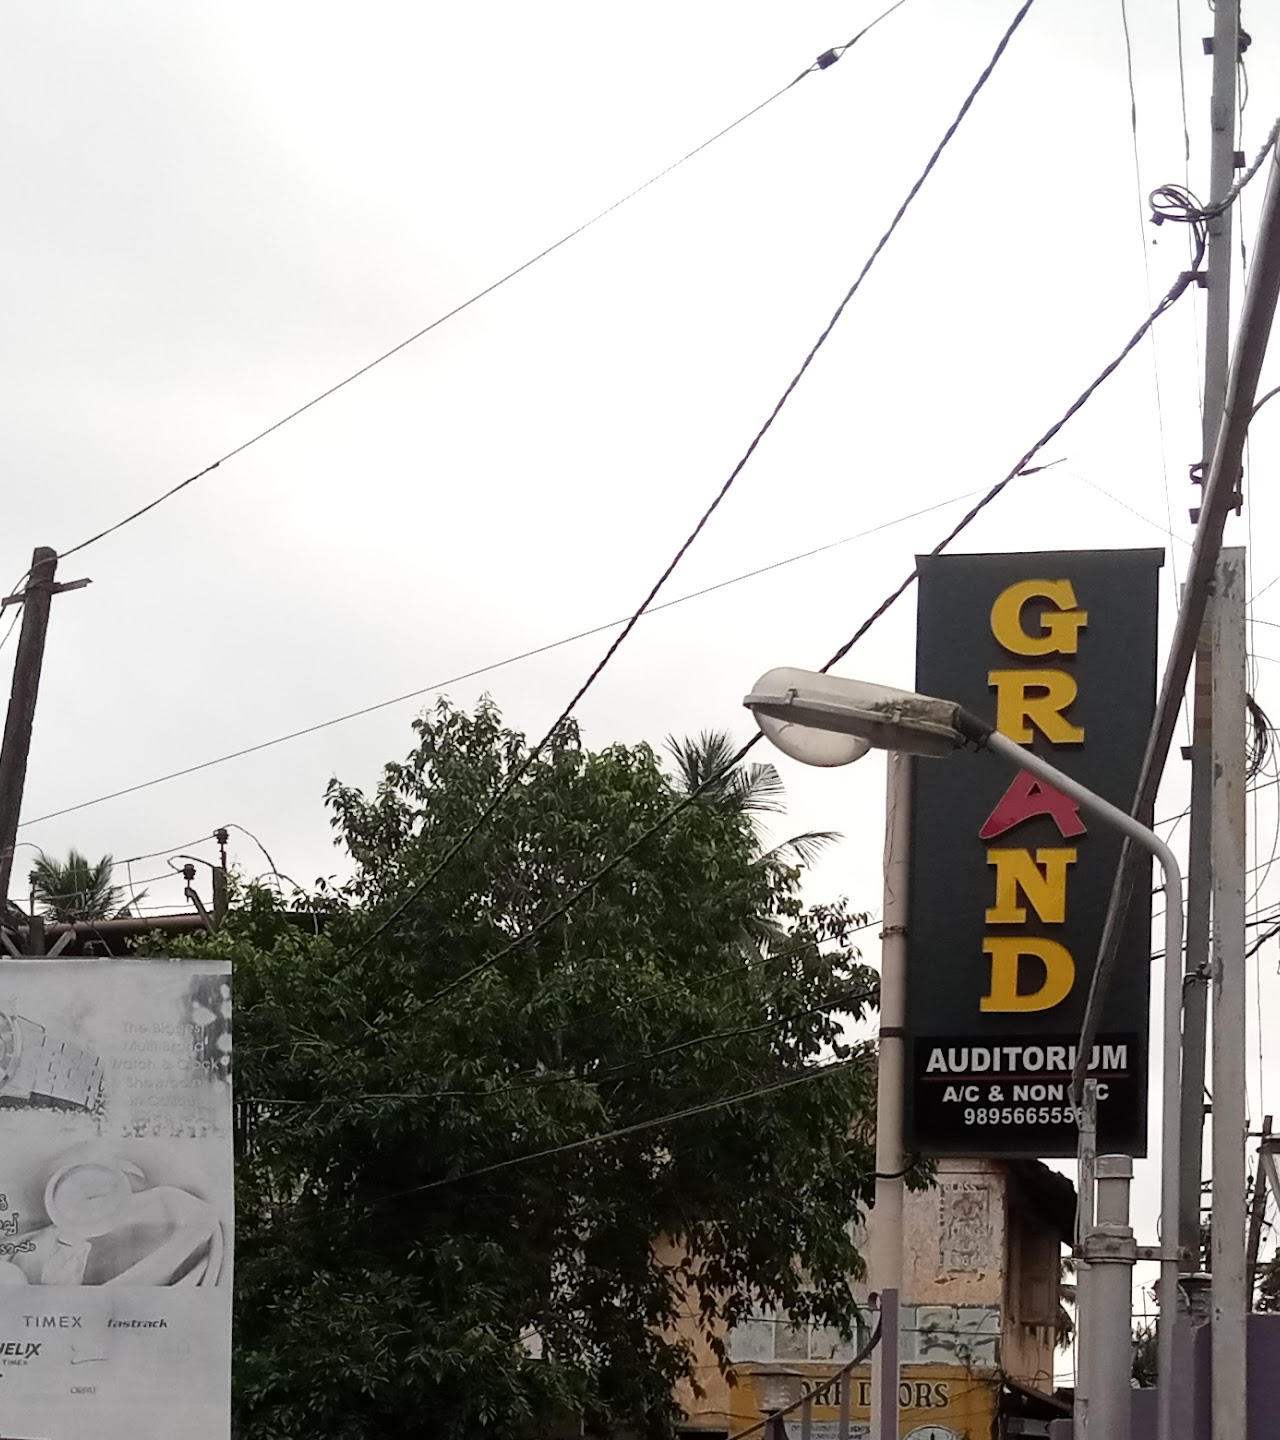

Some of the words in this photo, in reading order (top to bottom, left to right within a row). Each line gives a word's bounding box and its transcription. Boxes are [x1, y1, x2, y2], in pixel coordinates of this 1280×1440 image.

[979, 578, 1088, 1014] GRAND
[926, 1045, 1128, 1073] AUDITORIUM
[942, 1085, 980, 1102] A/C
[987, 1085, 1005, 1102] &
[1013, 1084, 1064, 1102] NON
[22, 1315, 83, 1328] TIMEX
